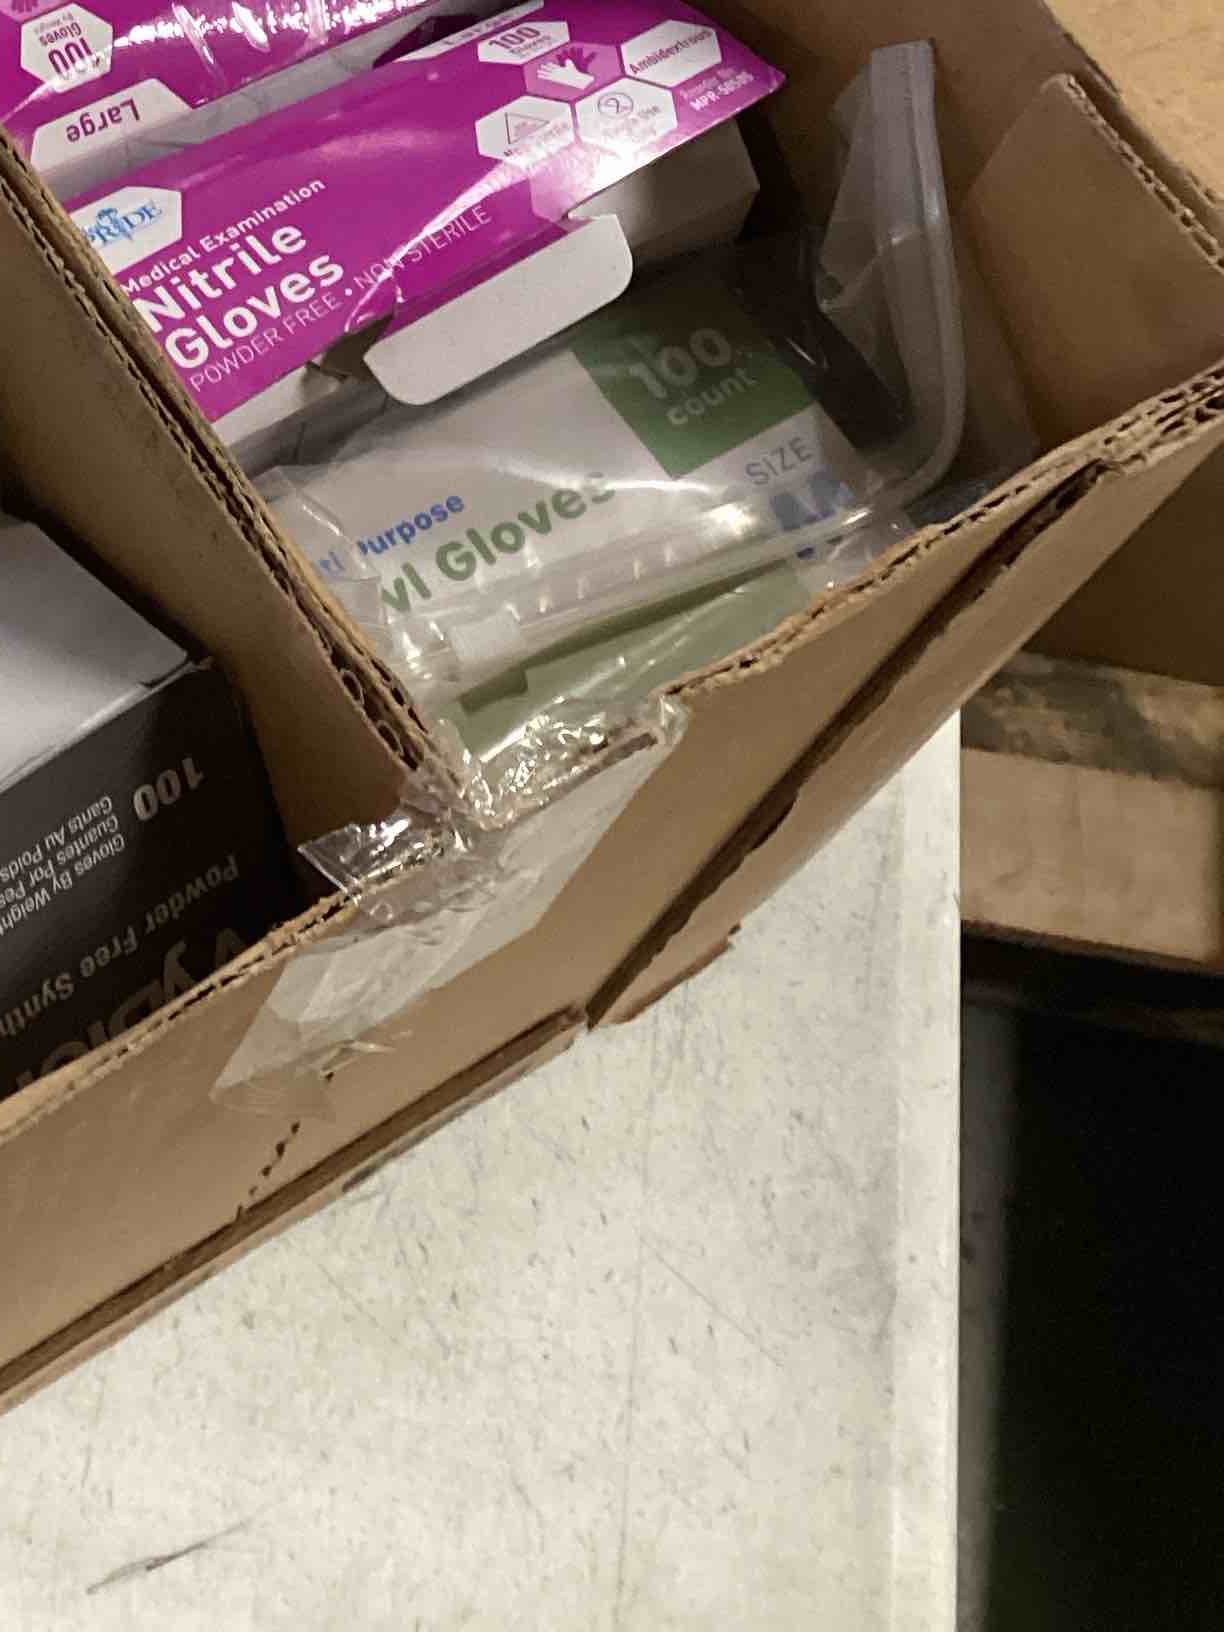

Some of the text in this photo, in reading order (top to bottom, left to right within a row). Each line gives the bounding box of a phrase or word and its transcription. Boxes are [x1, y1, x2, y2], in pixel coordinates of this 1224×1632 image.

[38, 22, 83, 47] Gloves
[488, 25, 542, 52] 100
[629, 29, 713, 75] Ambidextrous
[66, 99, 141, 143] Large
[121, 178, 326, 296] Medical Examination
[133, 223, 307, 335] Nitrile
[165, 253, 346, 369] Gloves
[189, 325, 284, 393] POWDER
[282, 291, 344, 335] FREE
[627, 327, 734, 402] 100
[665, 371, 759, 428] count
[745, 436, 815, 486] SIZE
[433, 472, 618, 583] Gloves
[68, 794, 113, 834] Gants
[133, 755, 205, 821] 100
[45, 823, 66, 849] Au
[56, 815, 120, 867] Guantes
[74, 833, 126, 877] Gloves
[29, 859, 55, 889] Por
[51, 870, 74, 894] By
[144, 854, 241, 937] Powder
[79, 925, 139, 979] Free
